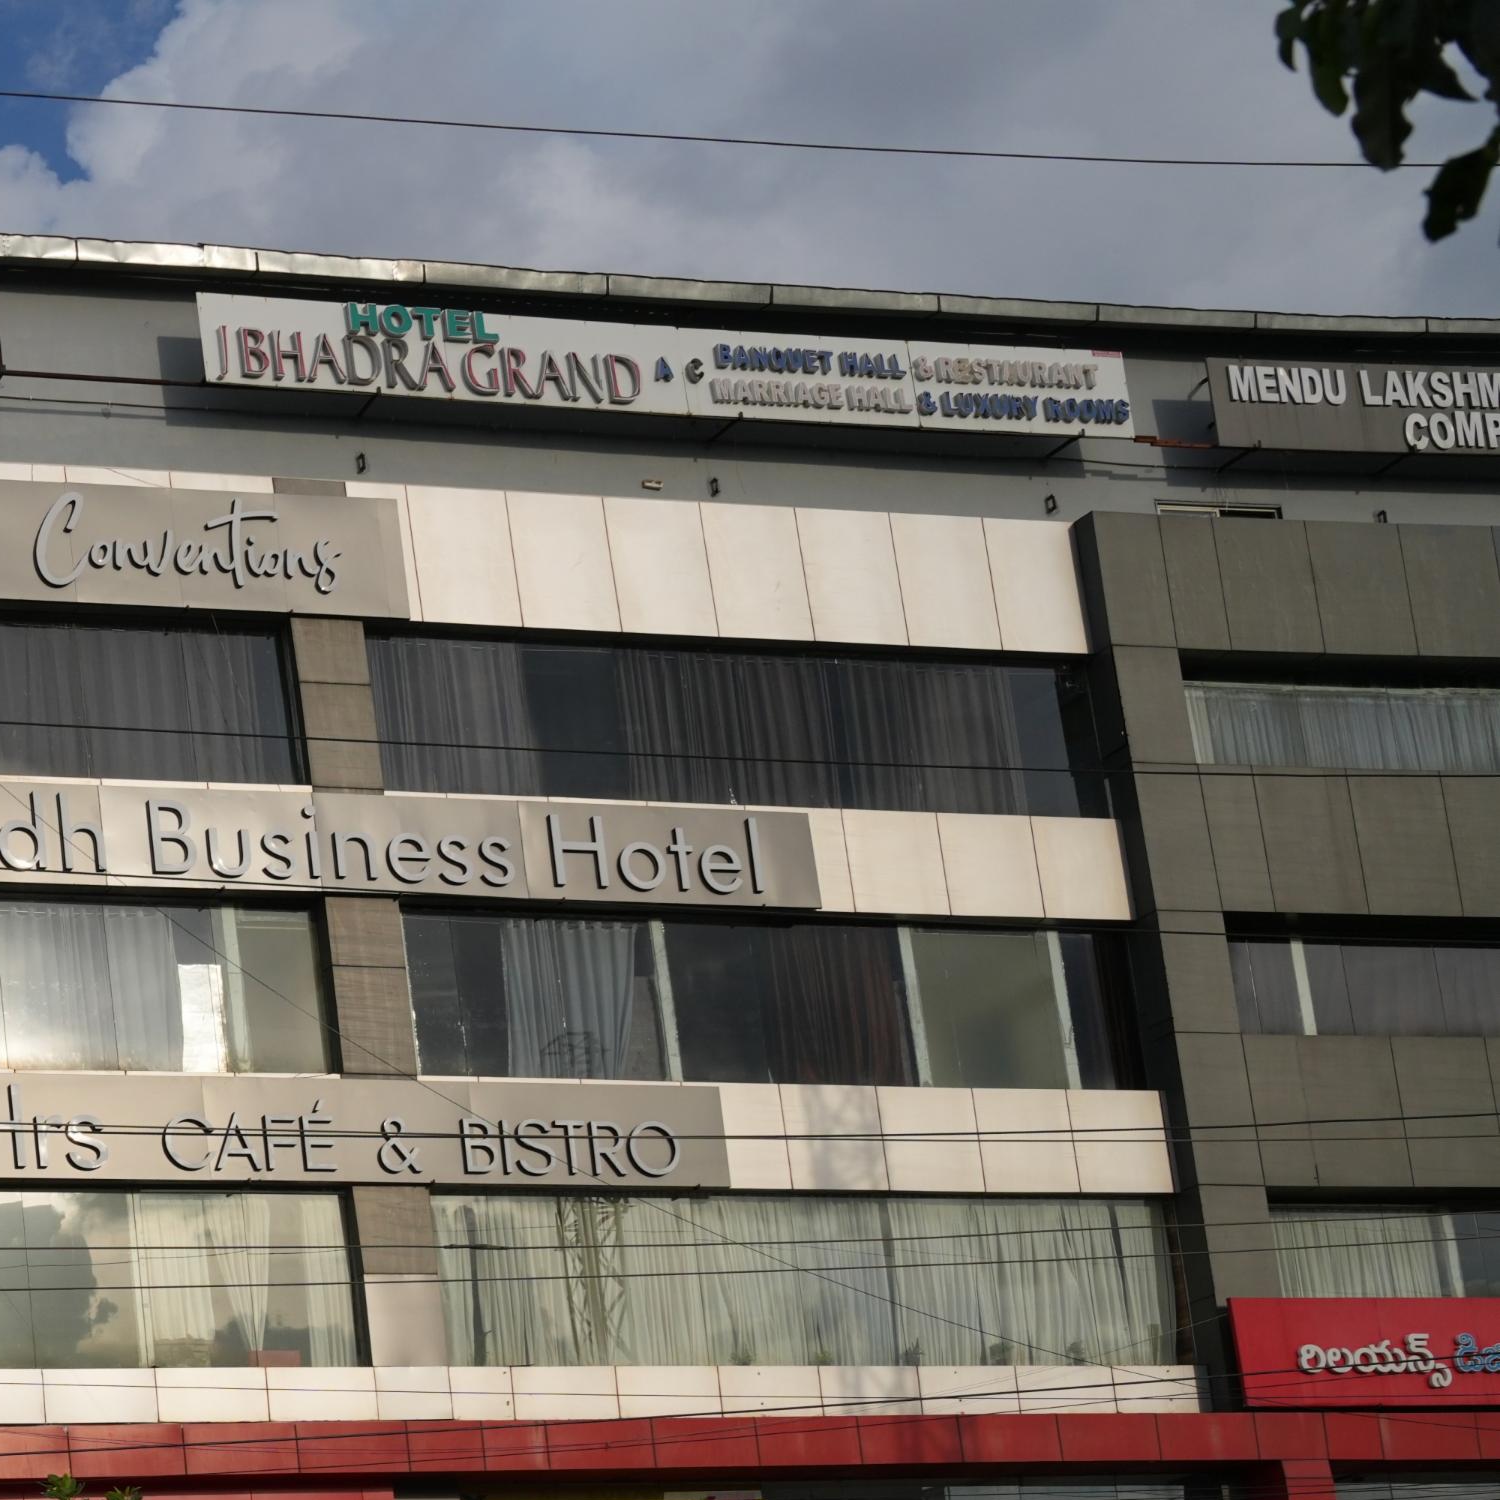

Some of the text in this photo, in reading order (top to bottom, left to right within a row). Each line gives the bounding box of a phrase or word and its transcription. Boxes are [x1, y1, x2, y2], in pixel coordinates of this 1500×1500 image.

[344, 302, 499, 343] HOTEL
[655, 356, 674, 382] A
[713, 343, 1099, 390] BANQUET HALL & RESTAURANT
[1227, 364, 1347, 405] MENDU
[709, 377, 1130, 426] MARRIAGE HALL & LUXURY ROOMS
[34, 490, 342, 593] Conventions
[147, 799, 516, 885] Business
[546, 813, 765, 894] Hotel
[162, 1099, 340, 1172] CAFÉ
[377, 1116, 422, 1174] &
[460, 1116, 682, 1178] BISTRO
